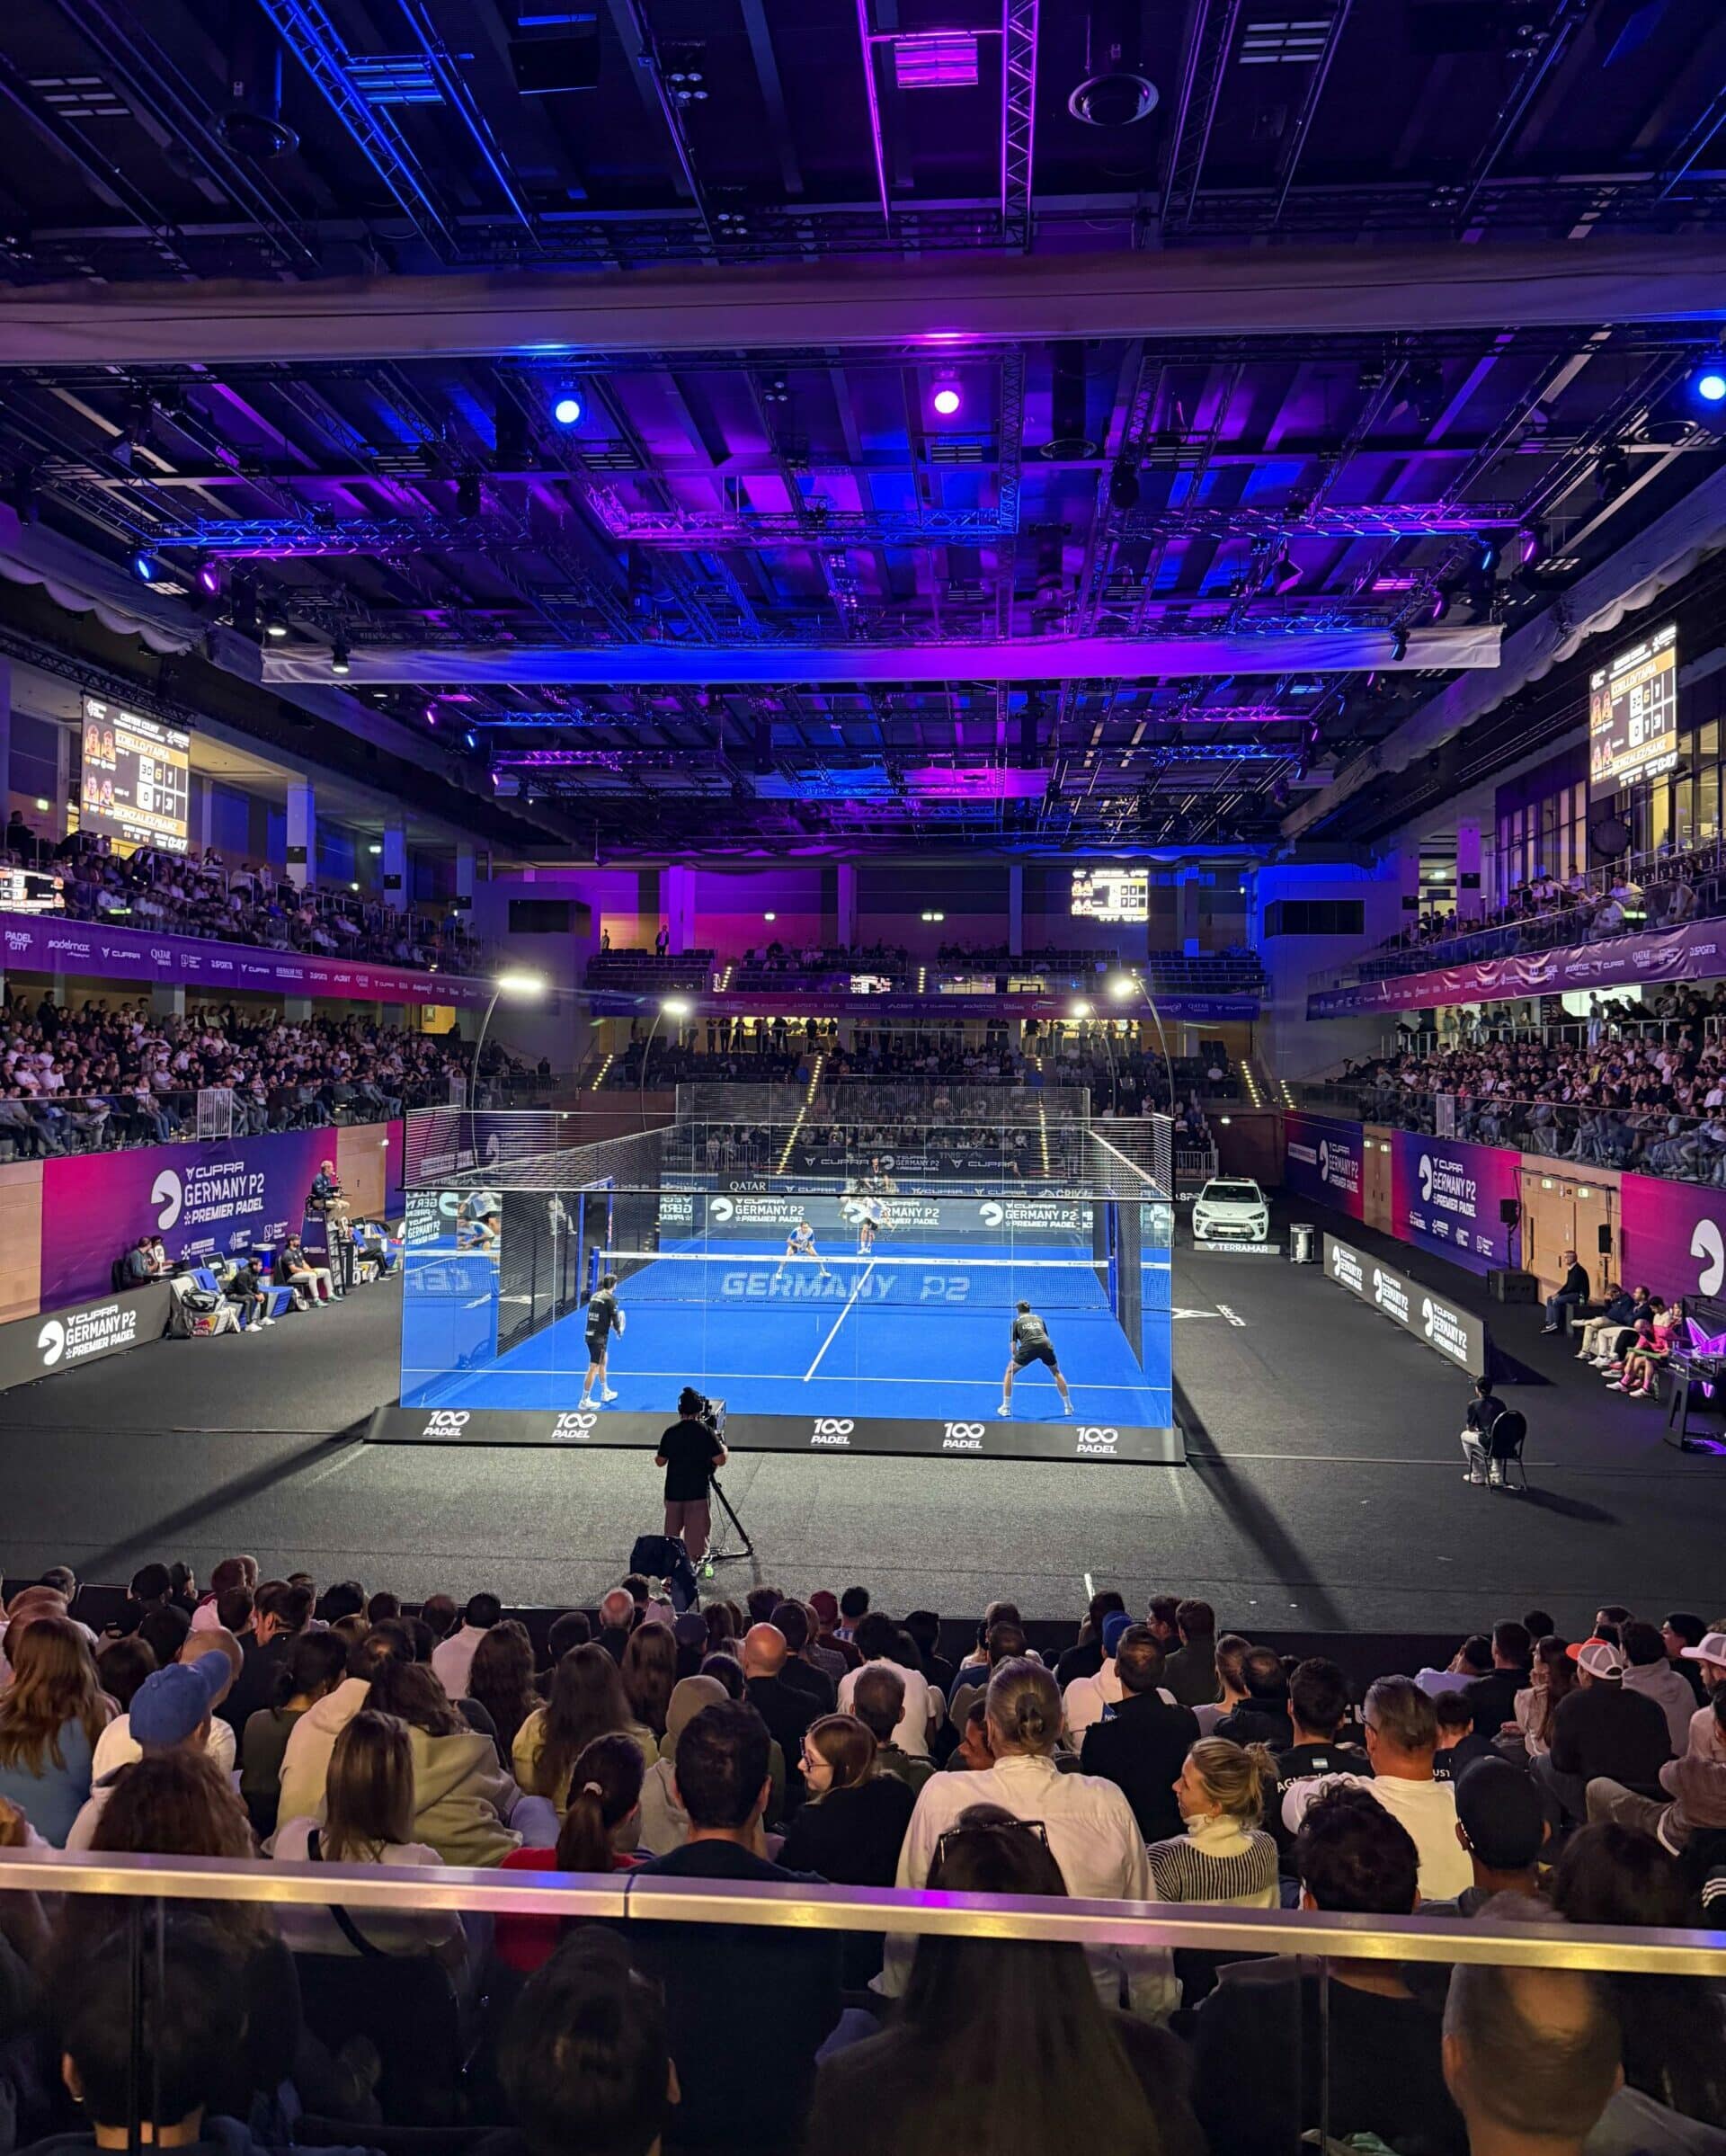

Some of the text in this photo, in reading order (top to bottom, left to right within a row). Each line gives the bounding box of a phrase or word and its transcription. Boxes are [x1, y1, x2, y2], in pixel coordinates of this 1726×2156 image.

[155, 769, 162, 780] 6
[4, 931, 33, 943] PADEL
[9, 941, 28, 952] CITY
[111, 950, 141, 959] CUPRA
[151, 949, 171, 960] QATAR
[195, 1161, 245, 1179] CUPRA
[1351, 1160, 1358, 1179] P2
[1439, 1159, 1464, 1174] CUPRA
[184, 1172, 264, 1207] GERMANY P2
[729, 1181, 766, 1192] QATAR
[1432, 1171, 1476, 1201] GERMANY P2
[191, 1197, 263, 1225] PREMIER PADEL
[735, 1205, 805, 1216] GERMANY P2
[925, 1208, 940, 1217] P2
[1437, 1194, 1476, 1217] PREMIER PADEL
[1005, 1210, 1077, 1221] GERMANY P2
[407, 1219, 440, 1239] GERMANY P2
[1218, 1243, 1268, 1253] TERRAMAR
[721, 1271, 971, 1301] GERMANY P2
[1383, 1282, 1409, 1311] GERMANY P2
[76, 1304, 119, 1324] CUPRA
[1437, 1305, 1457, 1324] CUPRA
[66, 1310, 137, 1346] GERMANY P2
[1434, 1314, 1467, 1350] GERMANY P2
[71, 1328, 136, 1359] PREMIER PADEL
[428, 1411, 470, 1426] 100
[556, 1412, 598, 1429] 100
[814, 1418, 855, 1435] 100
[423, 1427, 461, 1437] PADEL
[551, 1429, 590, 1439] PADEL
[943, 1422, 985, 1439] 100
[1076, 1427, 1118, 1444] 100
[811, 1435, 850, 1445] PADEL
[943, 1439, 983, 1449] PADEL
[1076, 1444, 1117, 1454] PADEL
